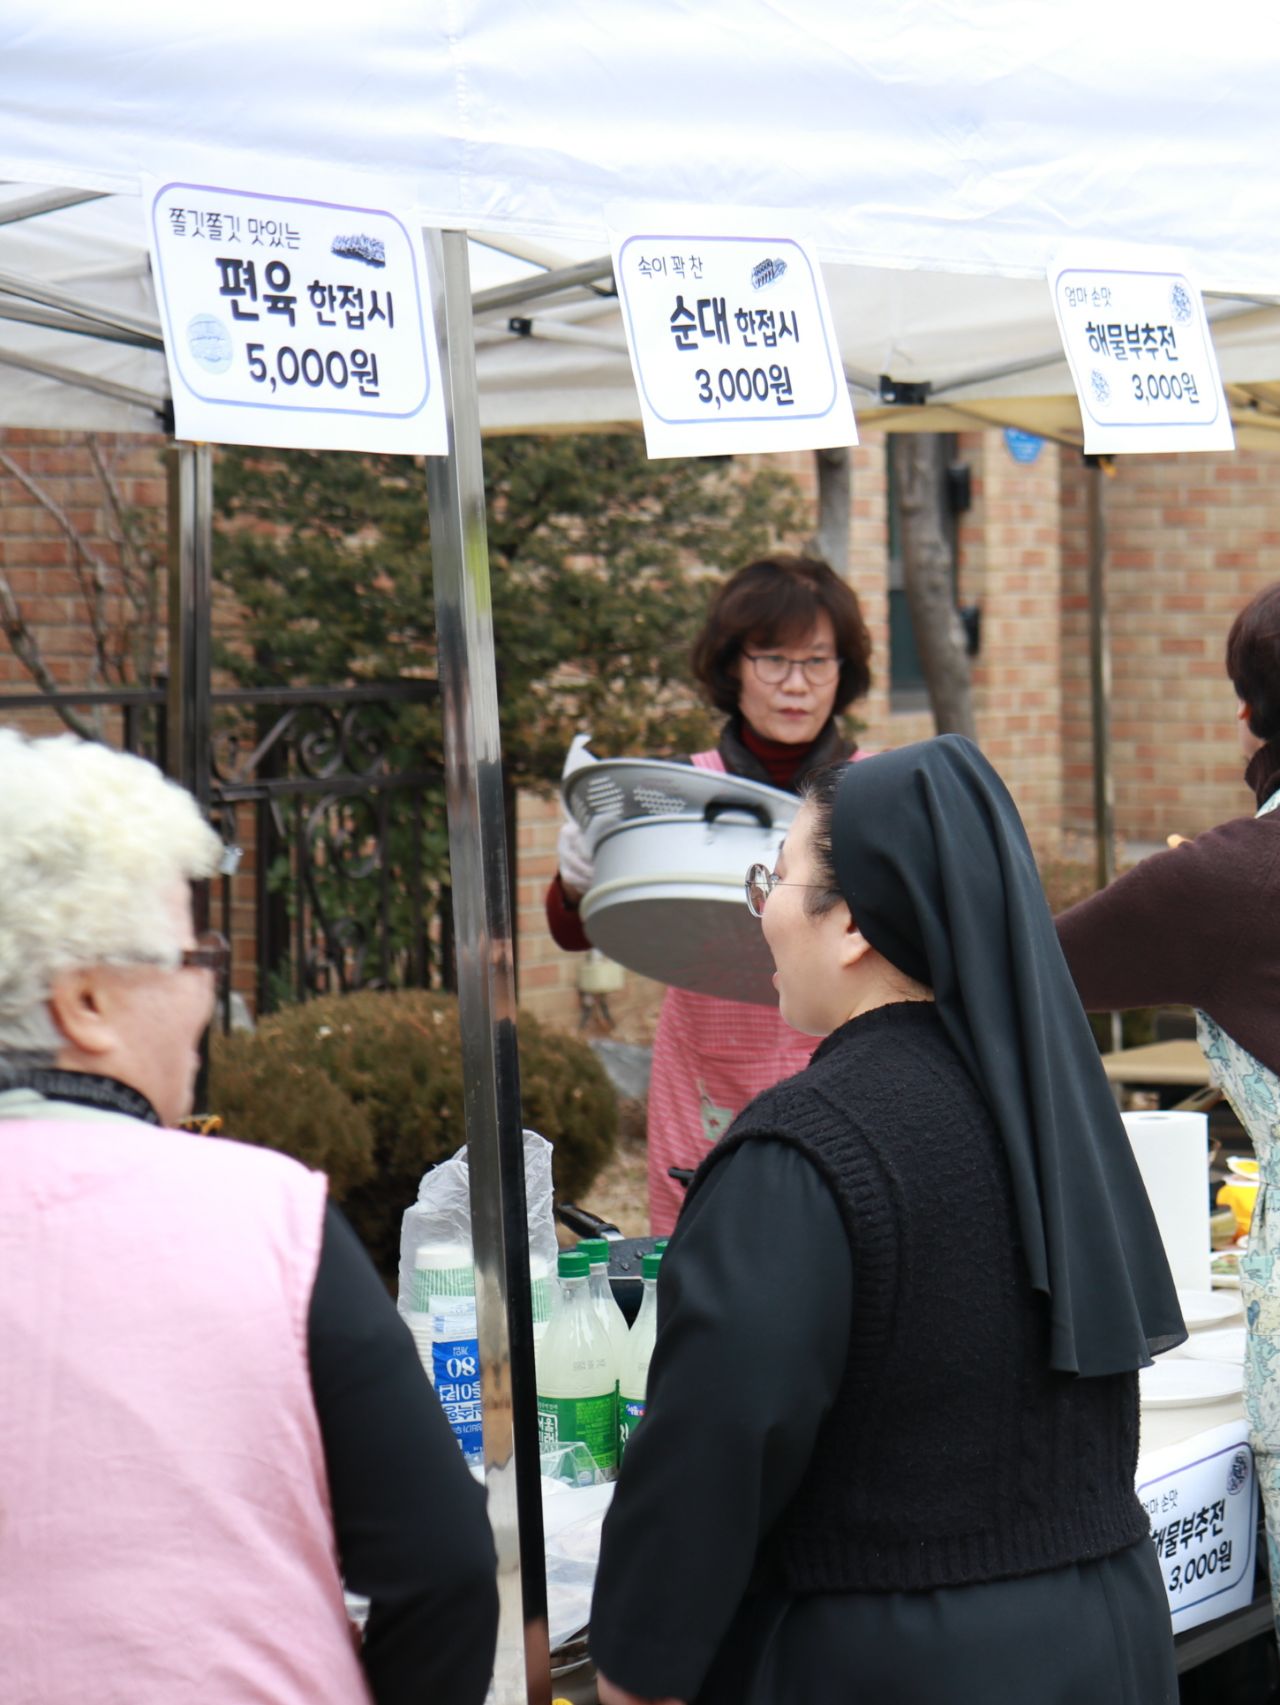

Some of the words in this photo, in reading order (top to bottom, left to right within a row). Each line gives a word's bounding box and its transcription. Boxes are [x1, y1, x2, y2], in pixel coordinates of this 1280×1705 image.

[169, 207, 241, 243] 쫄깃쫄깃
[247, 218, 300, 250] 맛있는
[637, 255, 668, 279] 속이
[689, 254, 704, 280] 찬
[215, 257, 298, 328] 편육
[307, 280, 395, 330] 한접시
[1065, 286, 1088, 308] 엄마
[670, 295, 731, 351] 순대
[734, 308, 800, 348] 한접시
[1085, 321, 1179, 362] 해물부추전
[246, 342, 380, 398] 5,000원
[695, 364, 795, 410] 3,000원
[1131, 372, 1200, 406] 3,000원
[446, 1356, 476, 1379] 80
[1168, 1540, 1232, 1594] 3,000원
